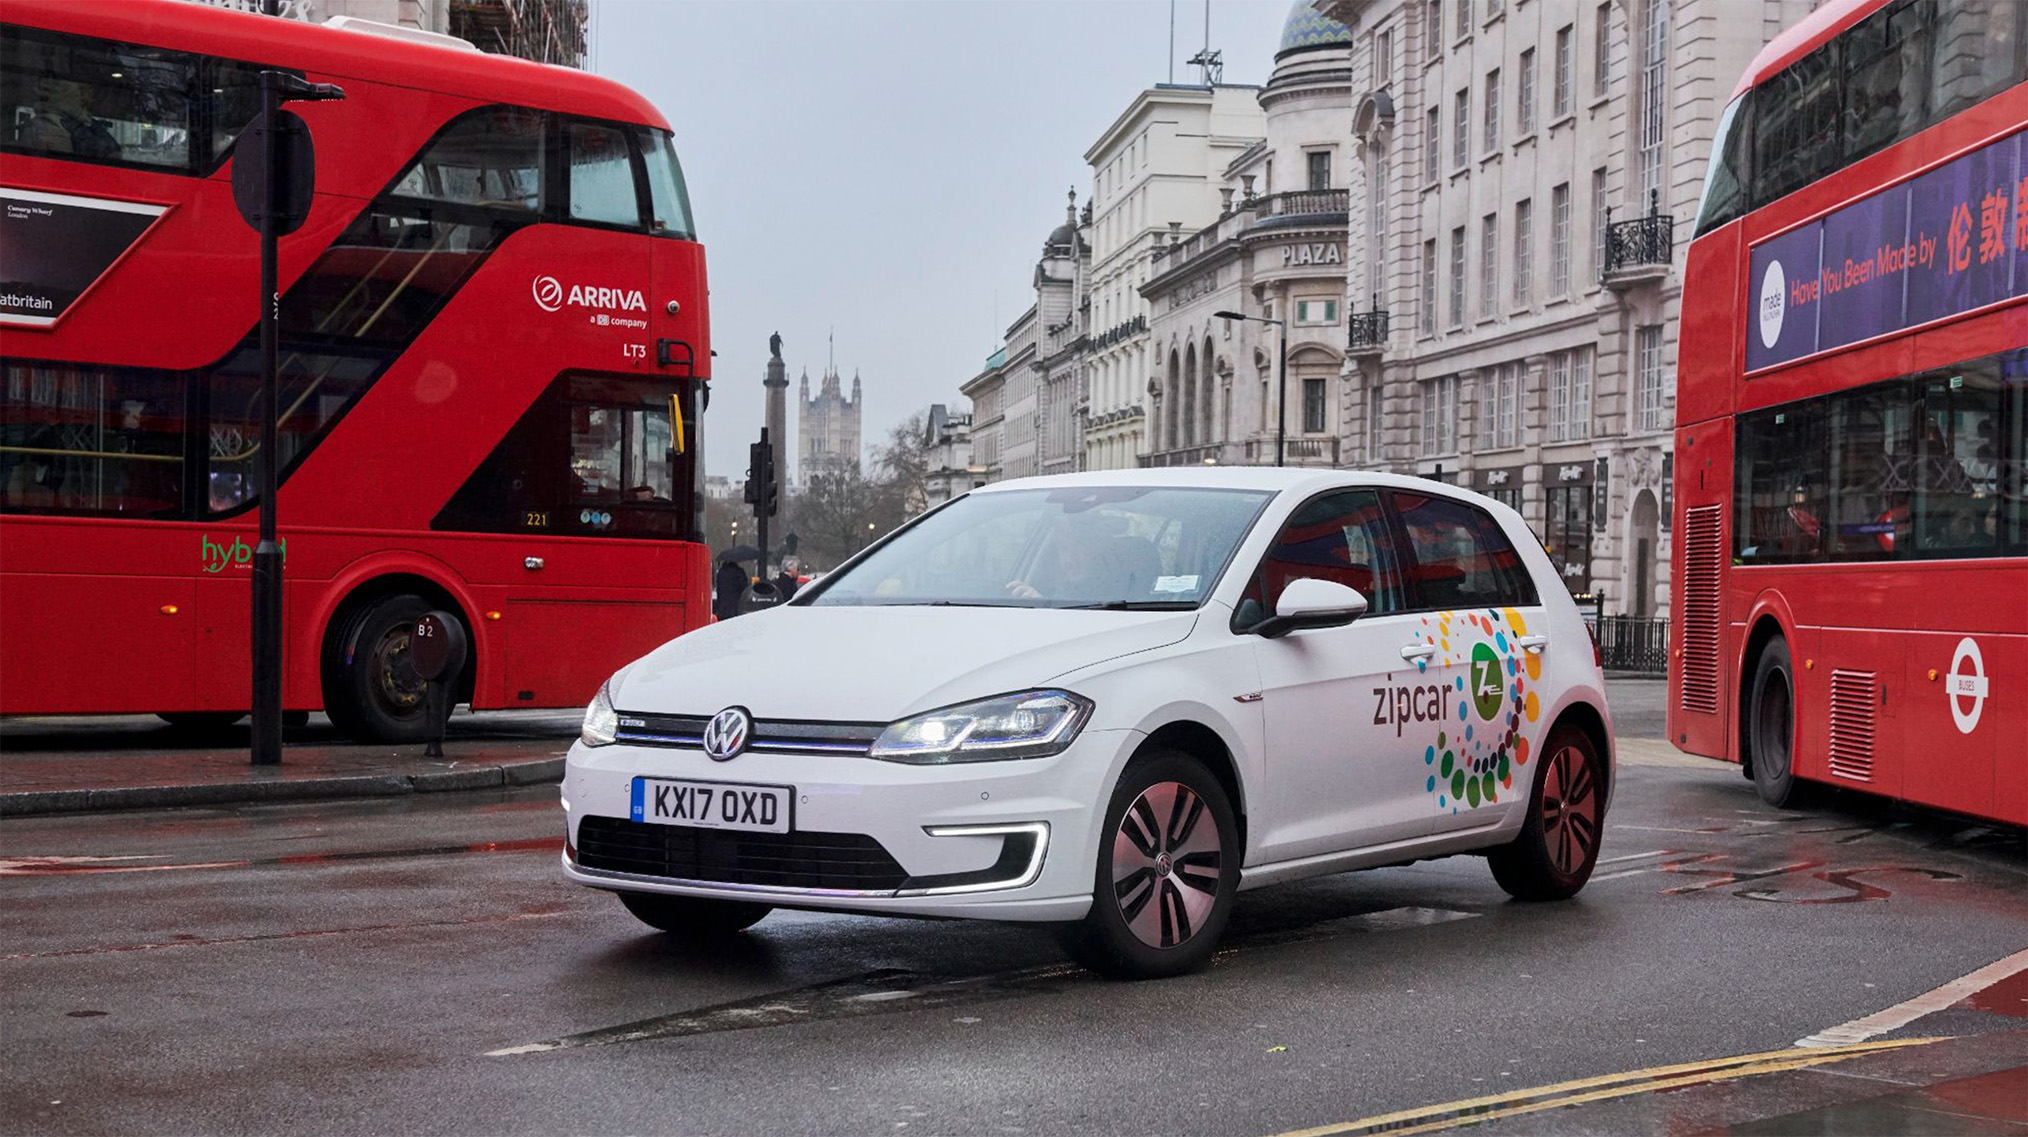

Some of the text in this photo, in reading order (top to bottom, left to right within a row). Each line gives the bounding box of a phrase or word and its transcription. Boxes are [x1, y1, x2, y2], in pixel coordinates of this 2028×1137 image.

[1281, 242, 1341, 265] PLAZA
[1790, 232, 1937, 307] Have You Been Made by
[567, 285, 647, 312] ARRIVA
[1763, 288, 1781, 311] made
[611, 317, 647, 330] company
[623, 343, 647, 358] LT3
[527, 513, 546, 526] 221
[1959, 679, 1975, 691] BUSES
[1373, 673, 1452, 737] zipcar
[655, 785, 778, 826] KX17 OXD
